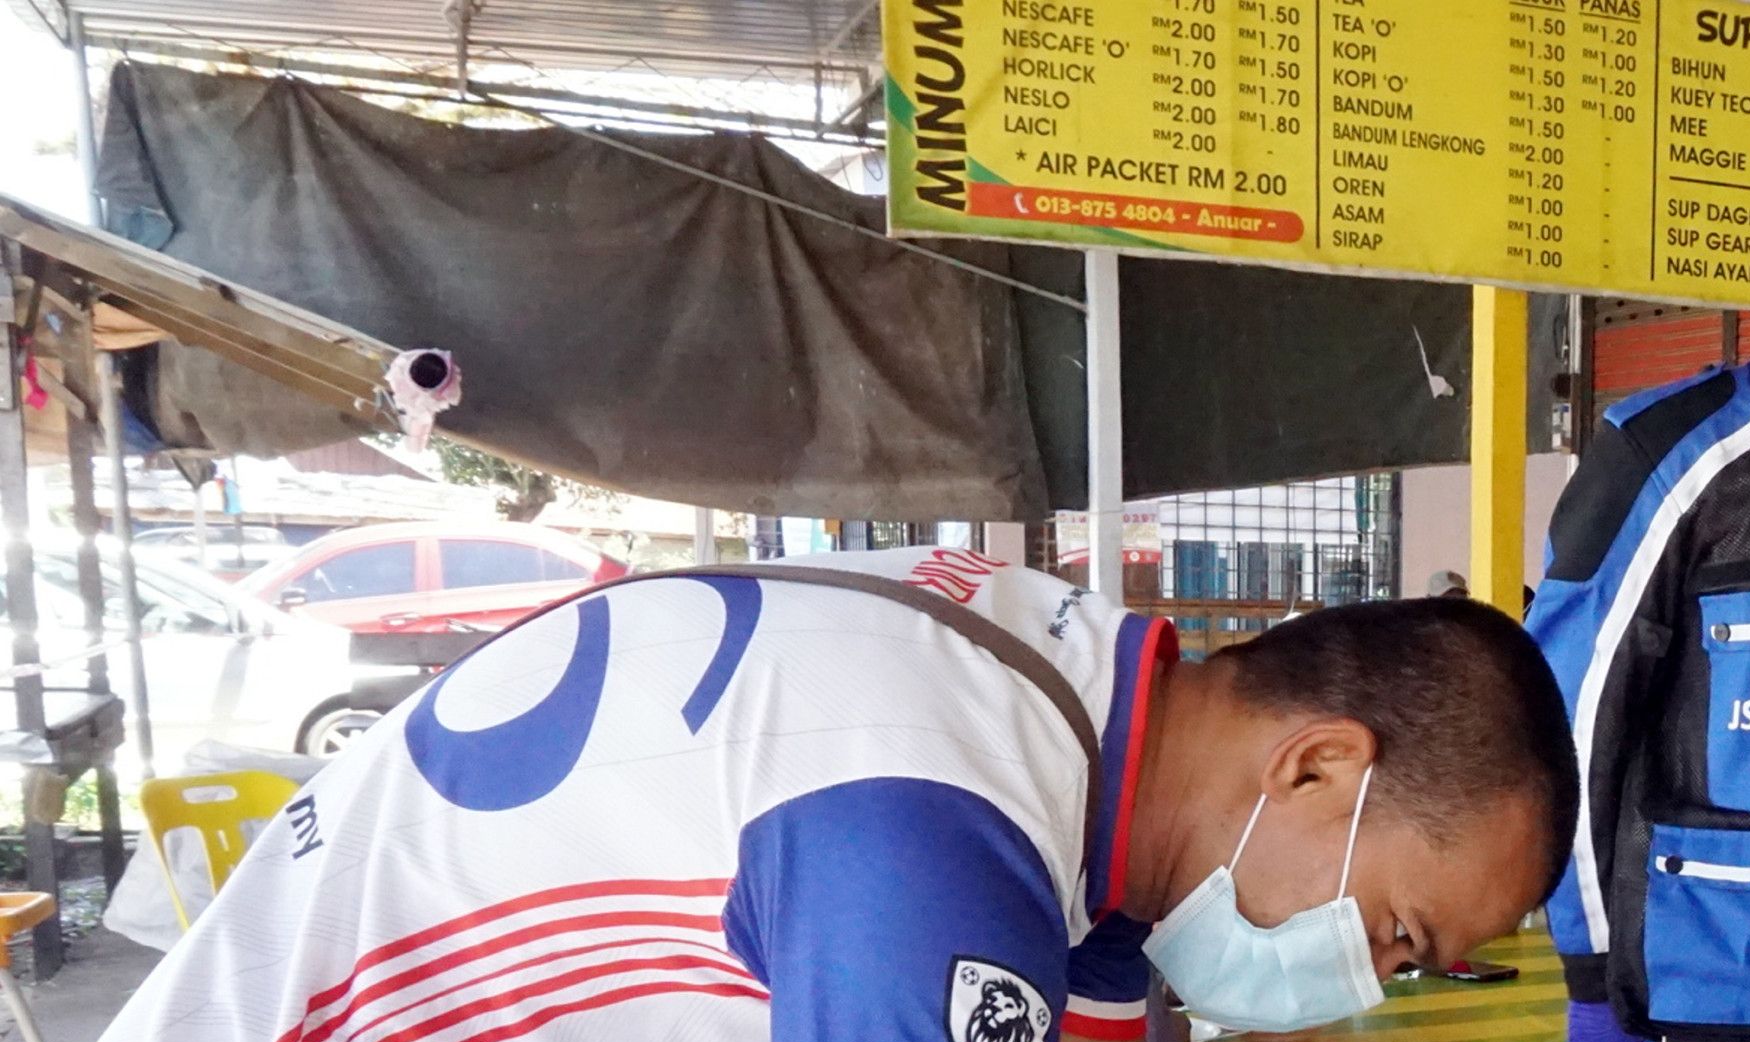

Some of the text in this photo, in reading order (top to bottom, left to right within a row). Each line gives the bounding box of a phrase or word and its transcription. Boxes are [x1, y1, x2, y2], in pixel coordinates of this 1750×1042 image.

[1002, 2, 1095, 27] NESCAFE
[1239, 1, 1300, 25] RM1.50
[1580, 0, 1641, 19] PANAS
[1152, 17, 1216, 42] RM2.00
[1333, 13, 1396, 37] TEA 'O'
[1510, 12, 1566, 37] RM1.50
[1582, 23, 1637, 47] RM1.20
[1002, 29, 1130, 59] NESCAFE 'O'
[1239, 28, 1300, 53] RM1.70
[1333, 41, 1376, 63] KOPI
[1510, 38, 1566, 62] RM1.30
[1152, 45, 1216, 70] RM1.70
[1239, 55, 1300, 80] RM1.50
[1582, 48, 1637, 73] RM1.00
[1672, 57, 1726, 82] BIHUN
[1003, 57, 1096, 84] HORLICK
[1333, 69, 1408, 92] KOPI 'O'
[1509, 64, 1565, 88] RM1.50
[1152, 73, 1216, 98] RM2.00
[1239, 83, 1300, 108] RM1.70
[1582, 74, 1637, 98] RM1.20
[1671, 86, 1720, 109] KUEY
[1004, 86, 1070, 110] NESLO
[1333, 95, 1413, 121] BANDUM
[1509, 90, 1565, 114] RM1.30
[1152, 101, 1216, 126] RM2.00
[1239, 110, 1300, 135] RM1.80
[1582, 99, 1637, 124] RM1.00
[1004, 115, 1057, 137] LAICI
[1509, 116, 1565, 139] RM1.50
[1670, 118, 1707, 137] MEE
[1152, 129, 1216, 153] RM2.00
[1333, 122, 1485, 156] BANDUM LENGKONG
[1333, 150, 1388, 172] LIMAU
[1509, 142, 1565, 166] RM2.00
[1670, 145, 1747, 171] MAGGIE
[1036, 153, 1287, 197] AIR PACKET RM 2.00
[1508, 168, 1564, 191] RM1.20
[1333, 177, 1385, 198] OREN
[1036, 195, 1117, 219] 013-875
[1122, 203, 1175, 225] 4804
[1197, 209, 1262, 232] Anuar
[1332, 204, 1385, 224] ASAM
[1508, 193, 1564, 217] RM1.00
[1668, 199, 1700, 219] SUP
[1333, 230, 1383, 250] SIRAP
[1508, 220, 1564, 243] RM1.00
[1667, 227, 1699, 248] SUP
[1508, 246, 1564, 268] RM1.00
[1667, 256, 1708, 278] NASI
